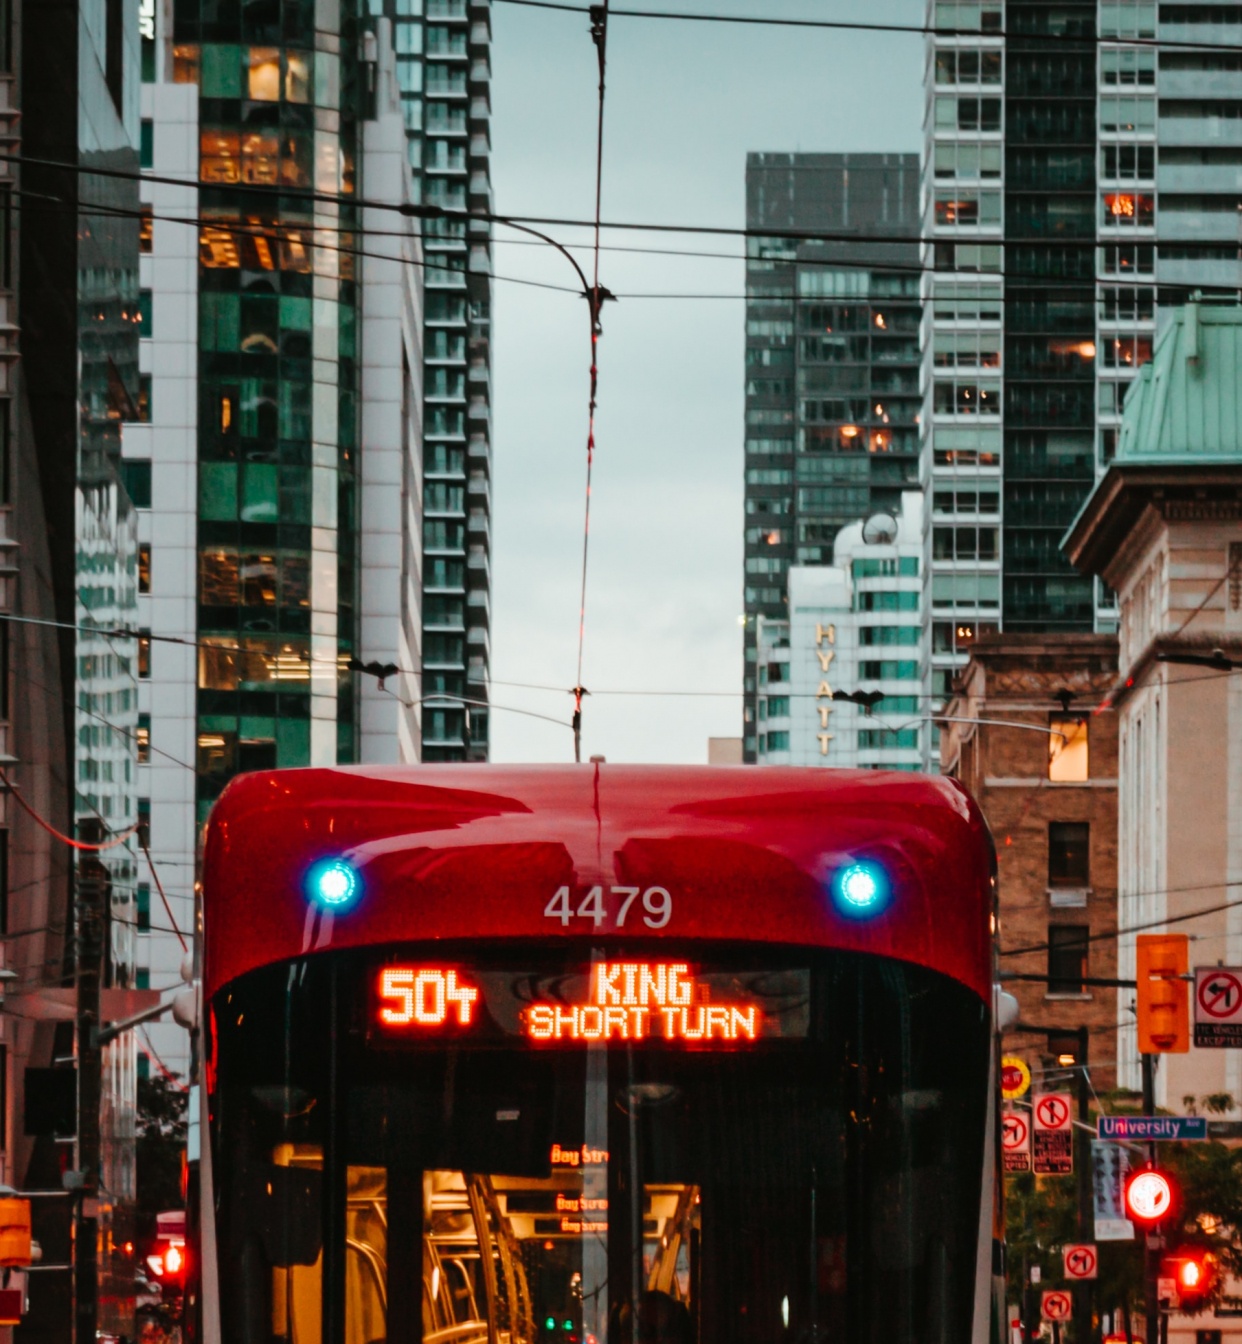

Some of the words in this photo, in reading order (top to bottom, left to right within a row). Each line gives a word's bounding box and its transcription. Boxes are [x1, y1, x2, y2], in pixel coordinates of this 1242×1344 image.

[816, 623, 835, 756] HYATT
[544, 885, 672, 928] 4479
[382, 969, 477, 1023] 504
[597, 963, 691, 1005] KING
[529, 1006, 649, 1039] SHORT
[661, 1006, 755, 1039] TURN
[1104, 1118, 1180, 1138] University
[551, 1144, 579, 1165] Bay
[557, 1193, 579, 1211] Bay
[561, 1216, 580, 1232] Bay
